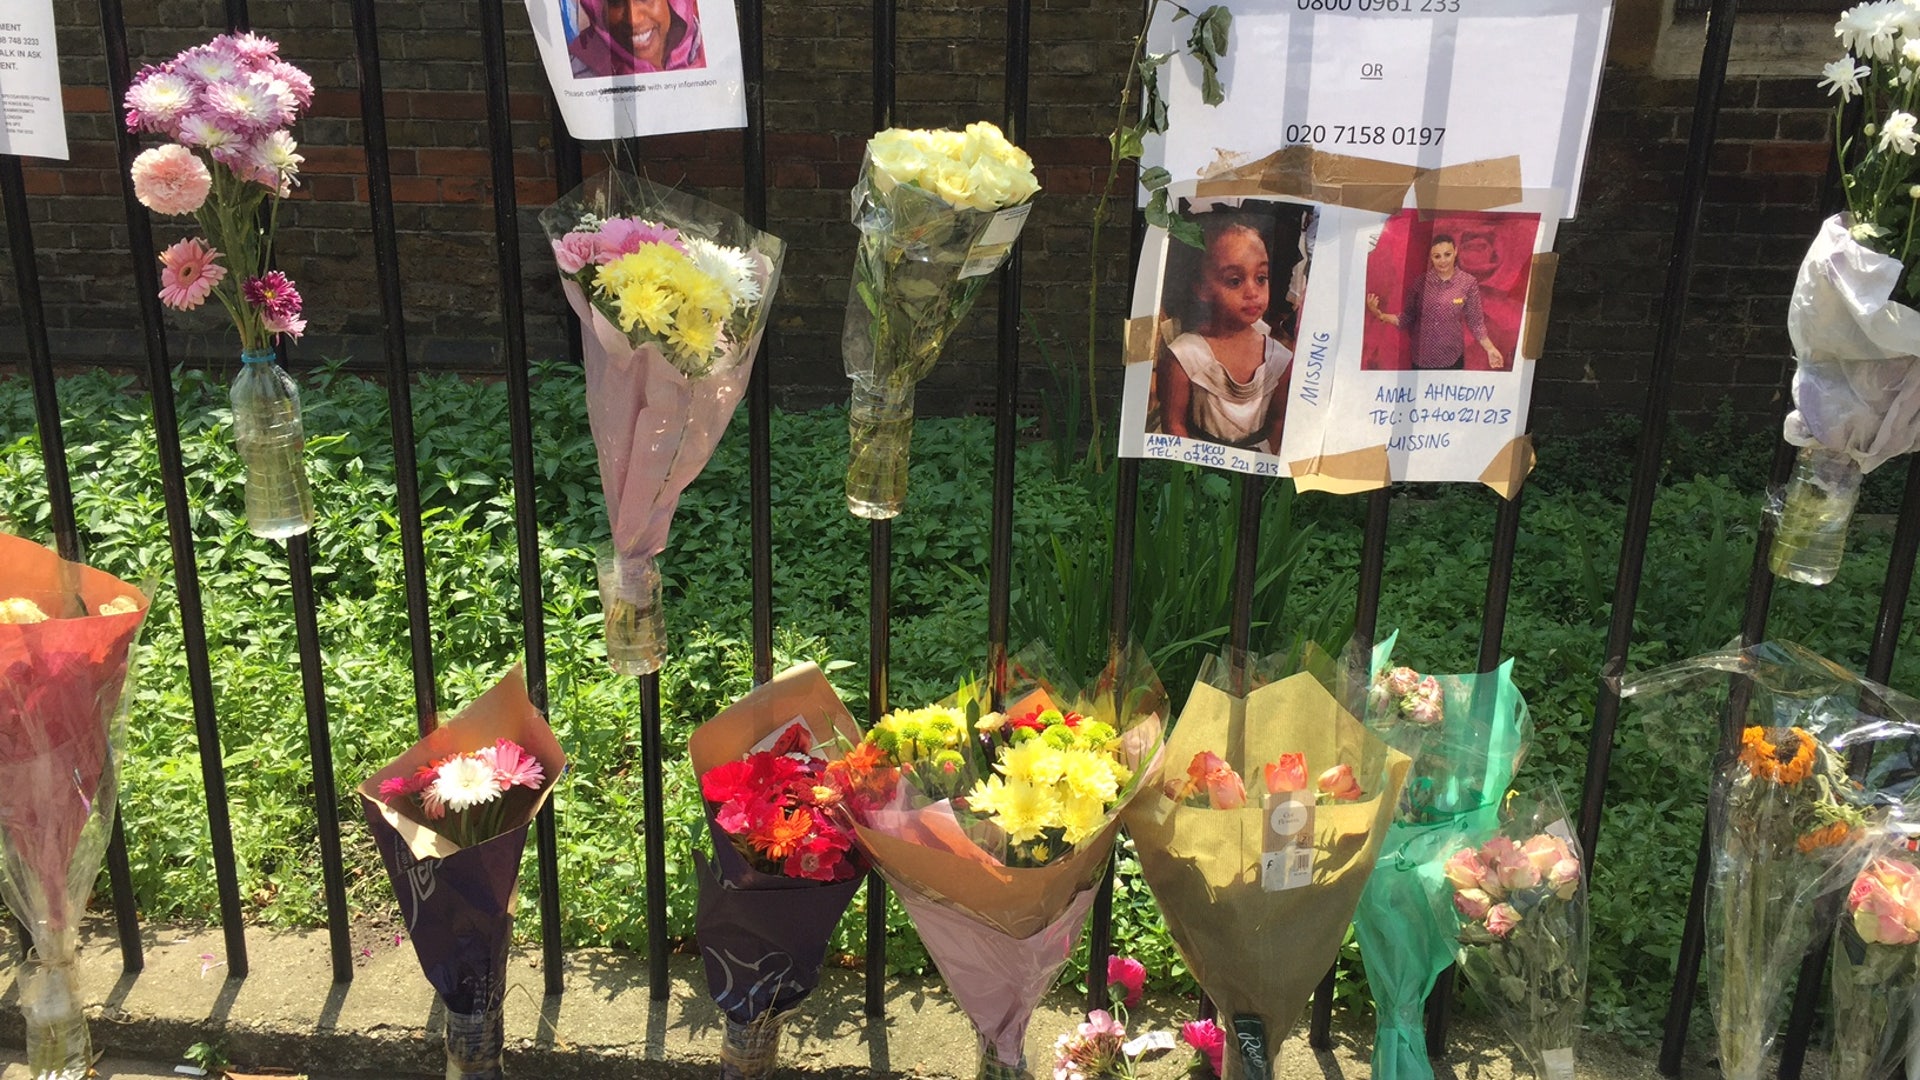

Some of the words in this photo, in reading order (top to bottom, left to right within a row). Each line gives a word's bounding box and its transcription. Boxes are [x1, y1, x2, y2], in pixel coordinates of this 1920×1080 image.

[1297, 0, 1350, 11] 0800
[1358, 0, 1411, 12] 0961
[1420, 0, 1461, 12] 233
[1360, 63, 1384, 80] OR
[664, 82, 677, 91] any
[678, 79, 717, 89] information
[1286, 124, 1326, 143] 020
[1333, 125, 1386, 145] 7158
[1392, 126, 1446, 146] 0197
[1300, 331, 1330, 406] MISSING
[1375, 386, 1416, 403] AMAL
[1385, 432, 1451, 451] MISSING
[1183, 451, 1225, 466] 07400
[1256, 462, 1278, 475] 213
